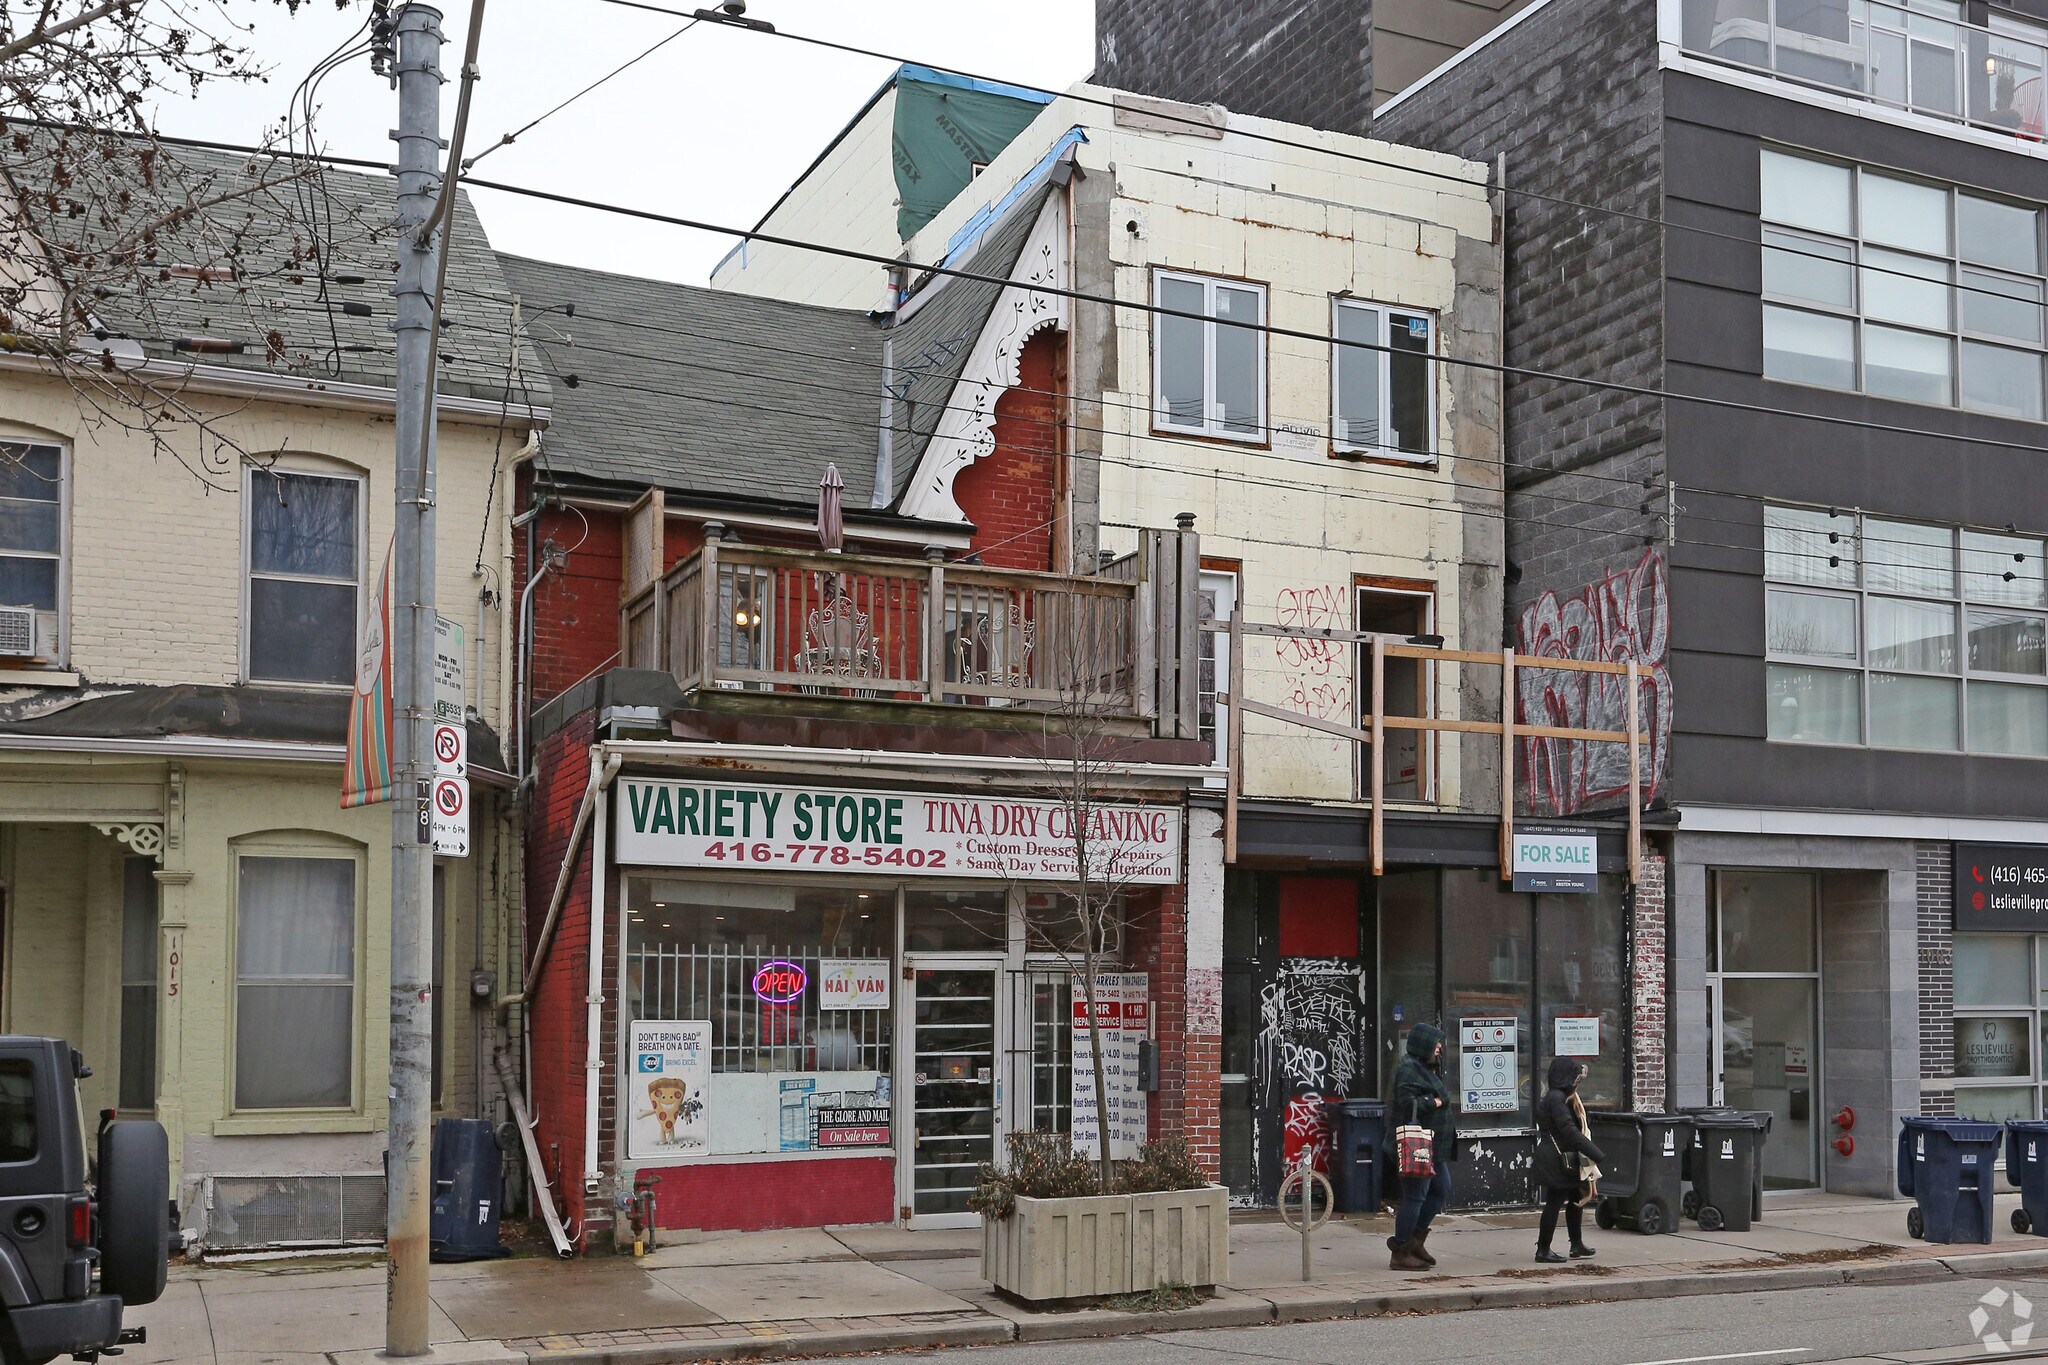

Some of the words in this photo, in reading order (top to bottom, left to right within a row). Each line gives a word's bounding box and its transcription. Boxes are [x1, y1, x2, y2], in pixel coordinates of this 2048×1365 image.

[446, 702, 461, 716] 5533
[627, 784, 782, 838] VARIETY
[792, 792, 904, 845] STORE
[922, 800, 984, 835] TINA
[990, 804, 1041, 838] DRY
[1047, 807, 1168, 844] CLEANING
[704, 842, 948, 867] 416-778-5402
[965, 838, 1022, 856] Custom
[1025, 842, 1079, 859] Dresses
[1111, 847, 1163, 862] Repairs
[1521, 845, 1552, 863] FOR
[1555, 846, 1591, 864] SALE
[966, 853, 1005, 870] Same
[1009, 856, 1037, 875] Day
[1104, 859, 1172, 878] Alteration
[1991, 865, 2021, 886] (416)
[2024, 867, 2048, 884] 465-
[168, 936, 179, 996] 1013
[756, 972, 804, 993] OPEN
[825, 975, 849, 993] HẢI
[857, 975, 885, 993] VÂN
[1073, 990, 1082, 998] Tel
[1108, 990, 1120, 998] 5402
[1083, 1004, 1090, 1015] 1
[1096, 1004, 1111, 1015] HR
[1128, 1005, 1133, 1016] 1
[1134, 1005, 1143, 1016] HR
[1074, 1017, 1090, 1027] REPA
[638, 1032, 659, 1042] DON'T
[660, 1032, 682, 1042] BRING
[683, 1032, 697, 1042] BAD
[1074, 1033, 1091, 1042] Hemm
[638, 1042, 665, 1051] BREATH
[667, 1042, 679, 1051] ON
[679, 1042, 686, 1051] A
[686, 1042, 702, 1051] DATE.
[1966, 1043, 2015, 1056] LESLIEVILLE
[665, 1059, 682, 1067] BRING
[1966, 1056, 2015, 1065] PROSTHODONTICS
[1075, 1083, 1092, 1094] Zipper
[1084, 1097, 1097, 1108] Shorte
[1466, 1102, 1515, 1110] 1-800-315-COOP
[819, 1110, 834, 1124] THE
[834, 1110, 858, 1124] GLOBE
[858, 1110, 873, 1123] AND
[873, 1108, 890, 1122] MAIL
[1086, 1115, 1099, 1124] Shorte
[830, 1131, 843, 1142] On
[843, 1130, 861, 1142] Sale
[861, 1129, 880, 1141] here
